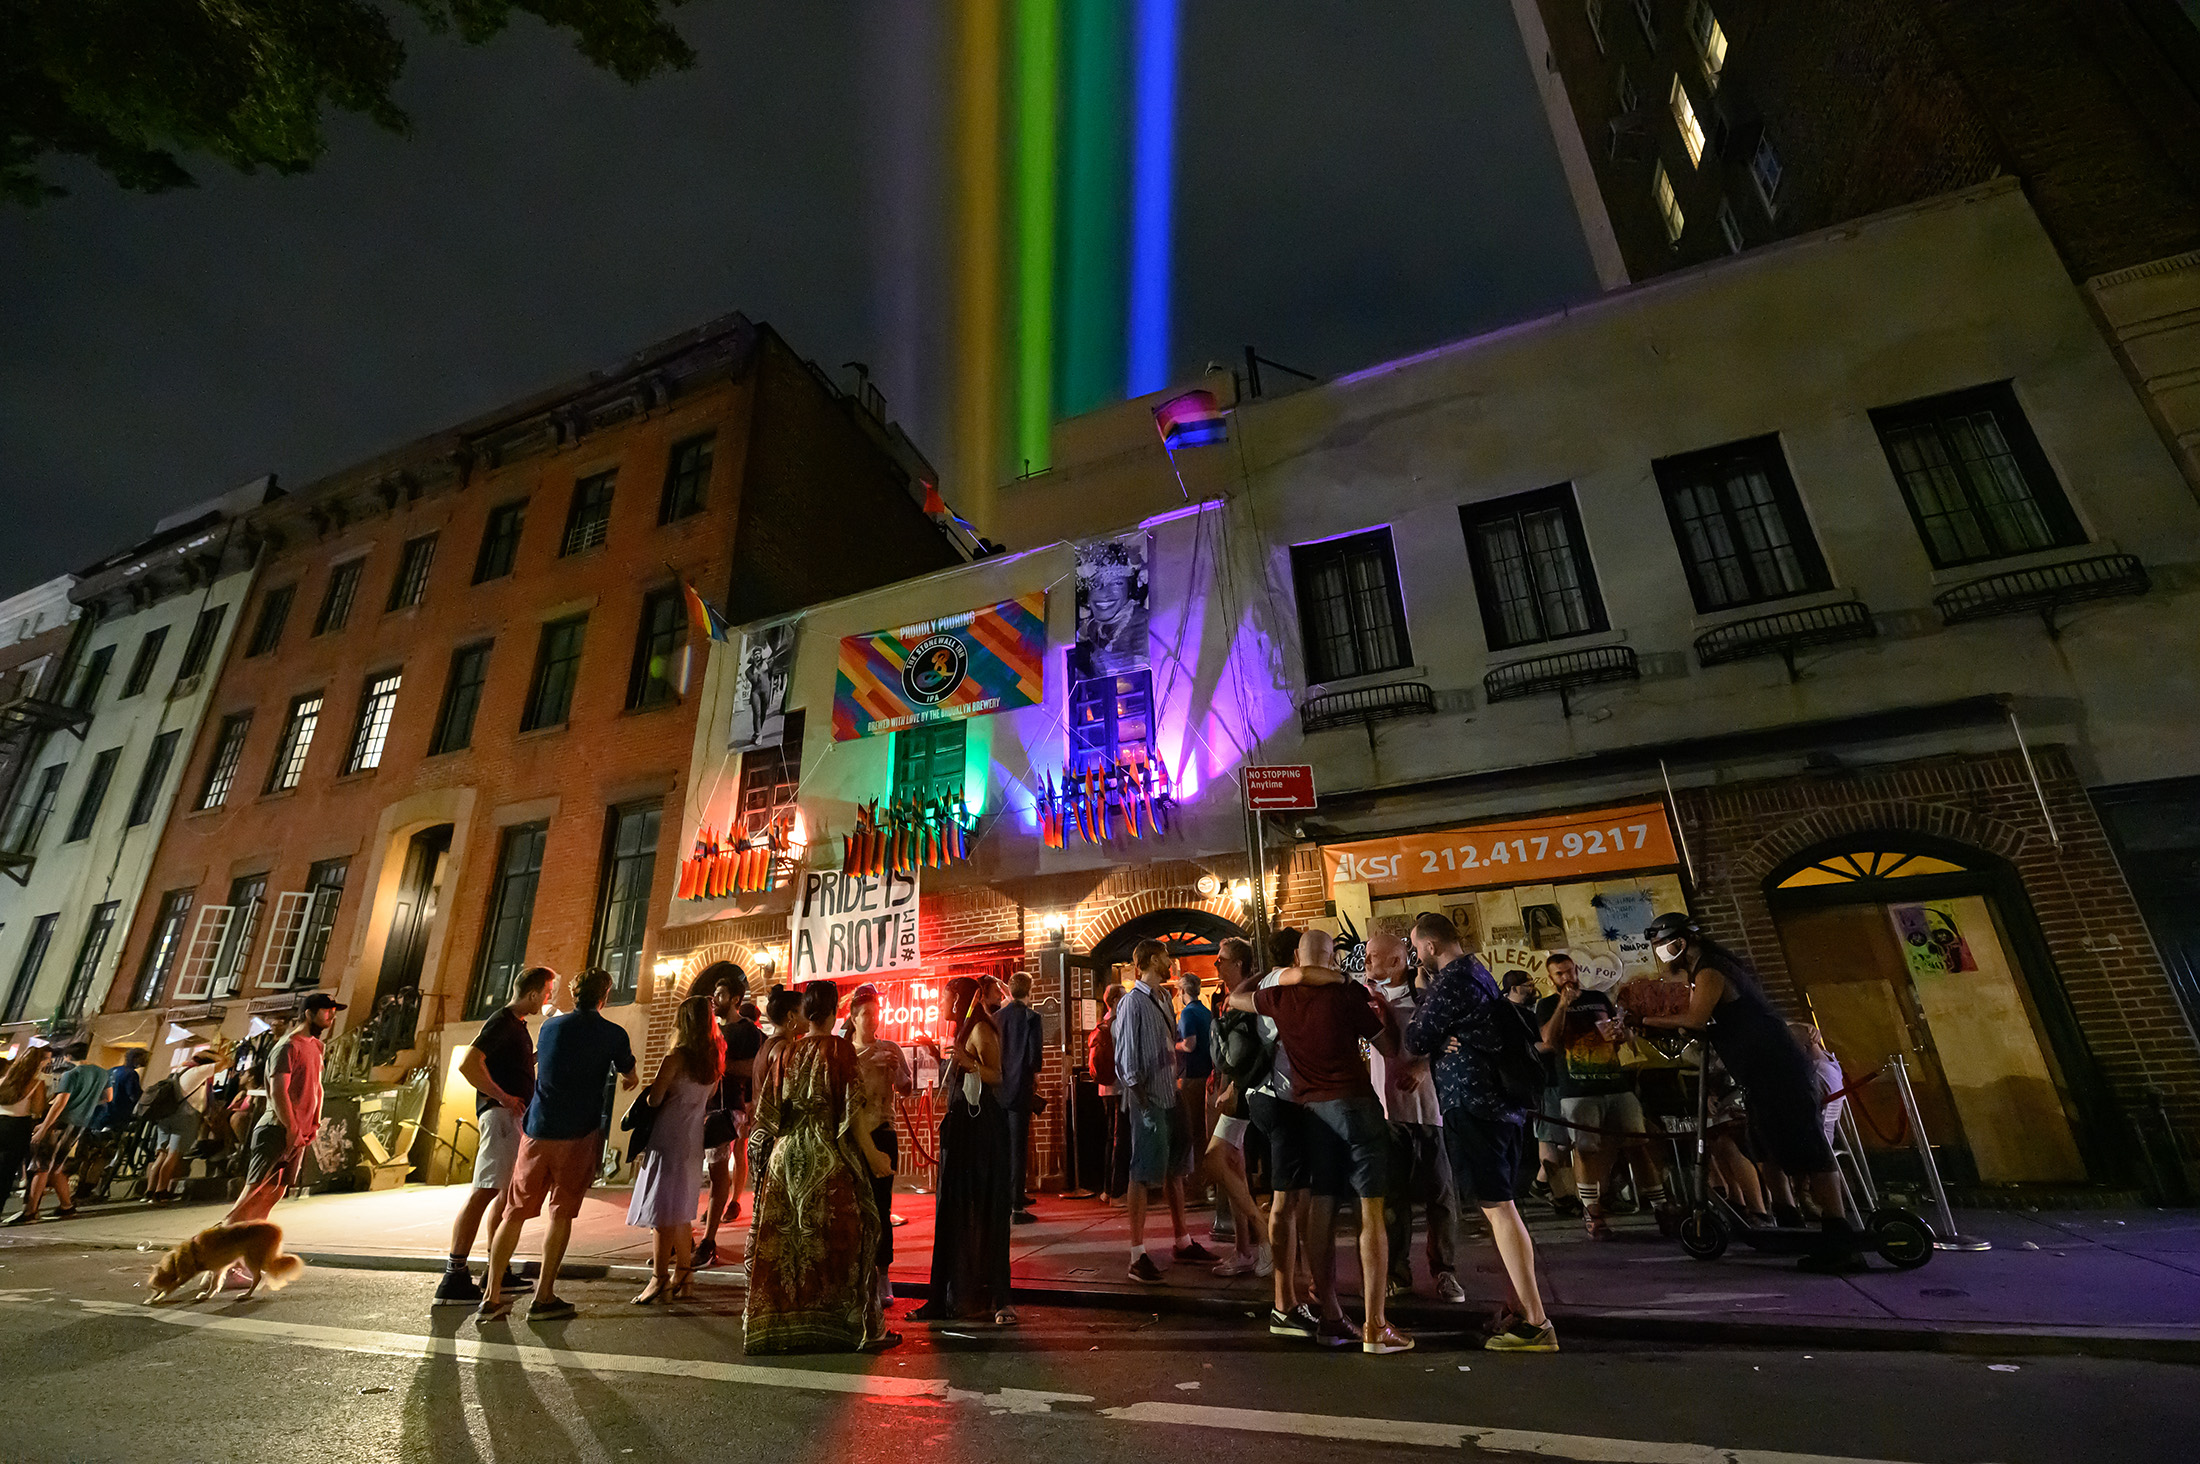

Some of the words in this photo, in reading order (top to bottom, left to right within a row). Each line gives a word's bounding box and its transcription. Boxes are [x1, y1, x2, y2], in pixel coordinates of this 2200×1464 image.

[900, 619, 936, 640] PROUDLY
[938, 610, 976, 632] POURING
[906, 654, 917, 669] THE
[916, 637, 955, 656] STONEWALL
[955, 645, 966, 659] INN
[926, 694, 940, 703] IPA
[867, 718, 890, 732] BREWED
[890, 716, 905, 727] WITH
[905, 713, 920, 724] LOVE
[920, 711, 929, 721] BY
[929, 709, 940, 720] THE
[941, 704, 971, 718] BROOKLYN
[972, 697, 1001, 712] BREWERY
[1249, 770, 1261, 779] NO
[1262, 769, 1301, 779] STOPPING
[1250, 780, 1284, 791] Anytime
[1419, 824, 1648, 874] 212.417.9217
[802, 871, 878, 918] PRIDE
[884, 868, 915, 908] IS
[797, 928, 817, 976] A
[826, 914, 901, 973] RIOT!
[900, 908, 916, 962] #BLM
[1619, 943, 1638, 953] NINA
[1637, 942, 1650, 951] POP
[1481, 949, 1543, 972] YLEEN
[1575, 964, 1591, 974] NA
[1595, 967, 1617, 979] POP
[910, 983, 939, 1000] The
